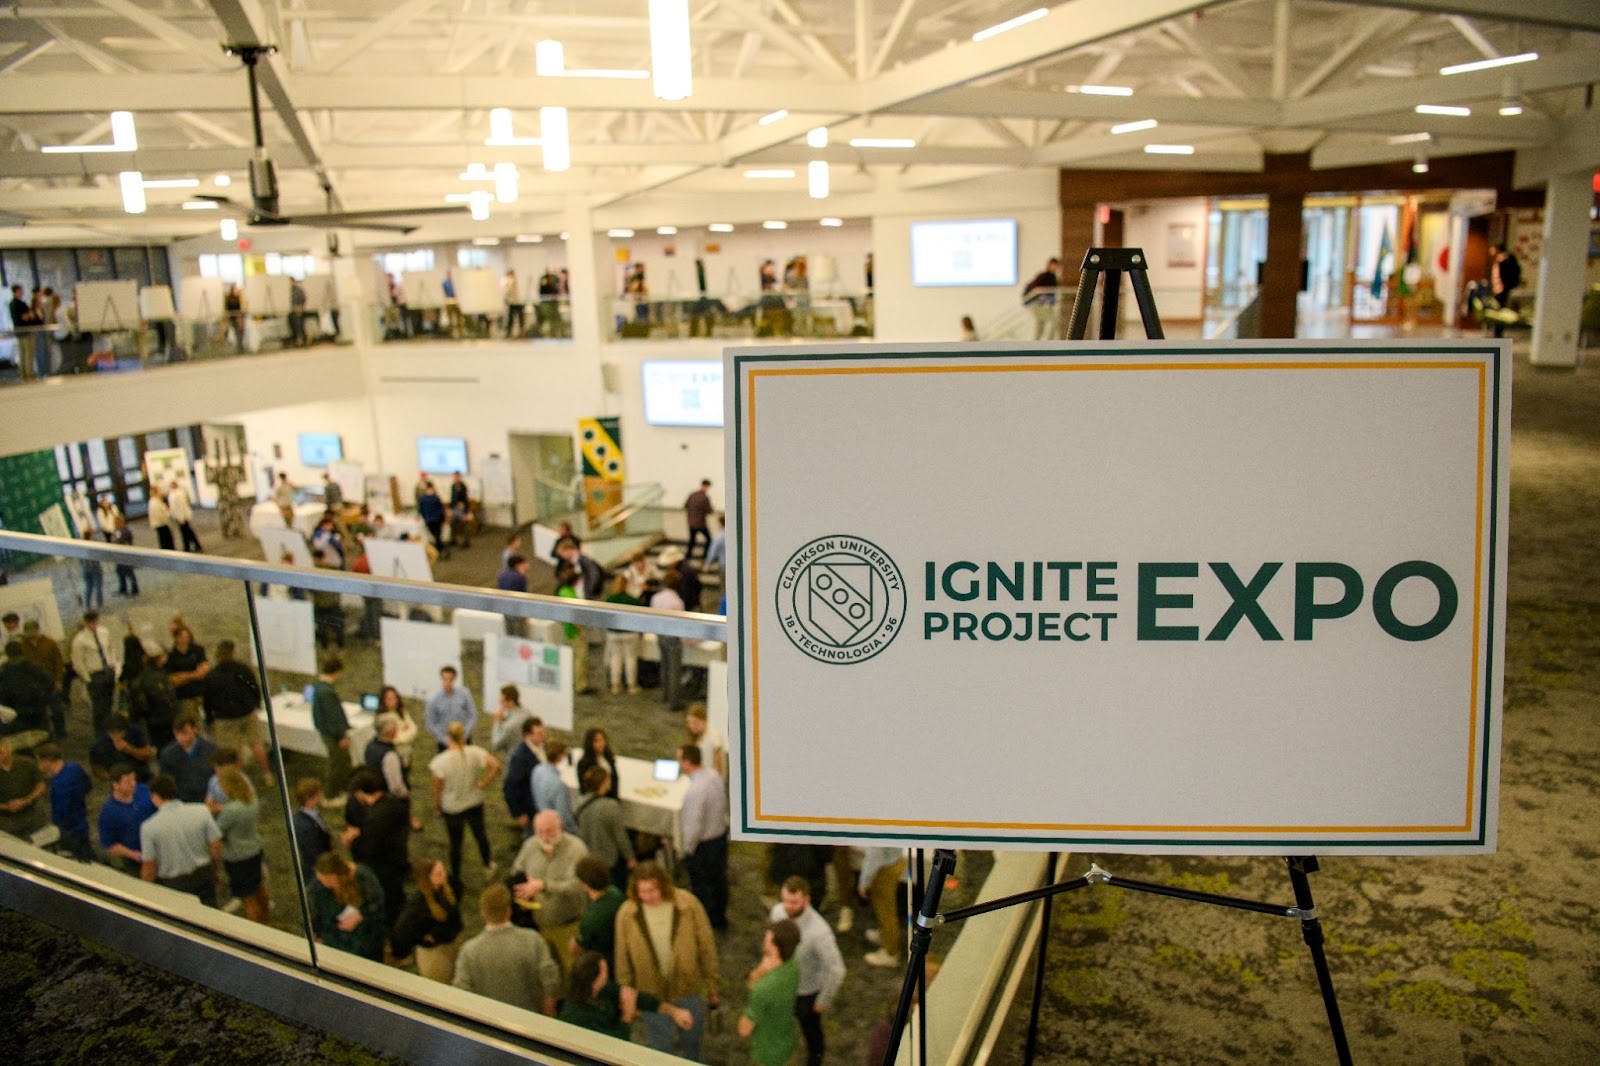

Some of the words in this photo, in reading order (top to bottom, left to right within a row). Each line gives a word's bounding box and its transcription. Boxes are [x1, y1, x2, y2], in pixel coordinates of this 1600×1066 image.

[783, 540, 835, 590] CLARKSON
[840, 540, 900, 590] UNIVERSITY
[925, 560, 1118, 602] IGNITE
[1137, 559, 1458, 642] EXPO
[785, 615, 795, 628] 18
[799, 634, 882, 660] TECHNOLOGIA
[885, 617, 898, 632] 96
[924, 611, 1118, 642] PROJECT
